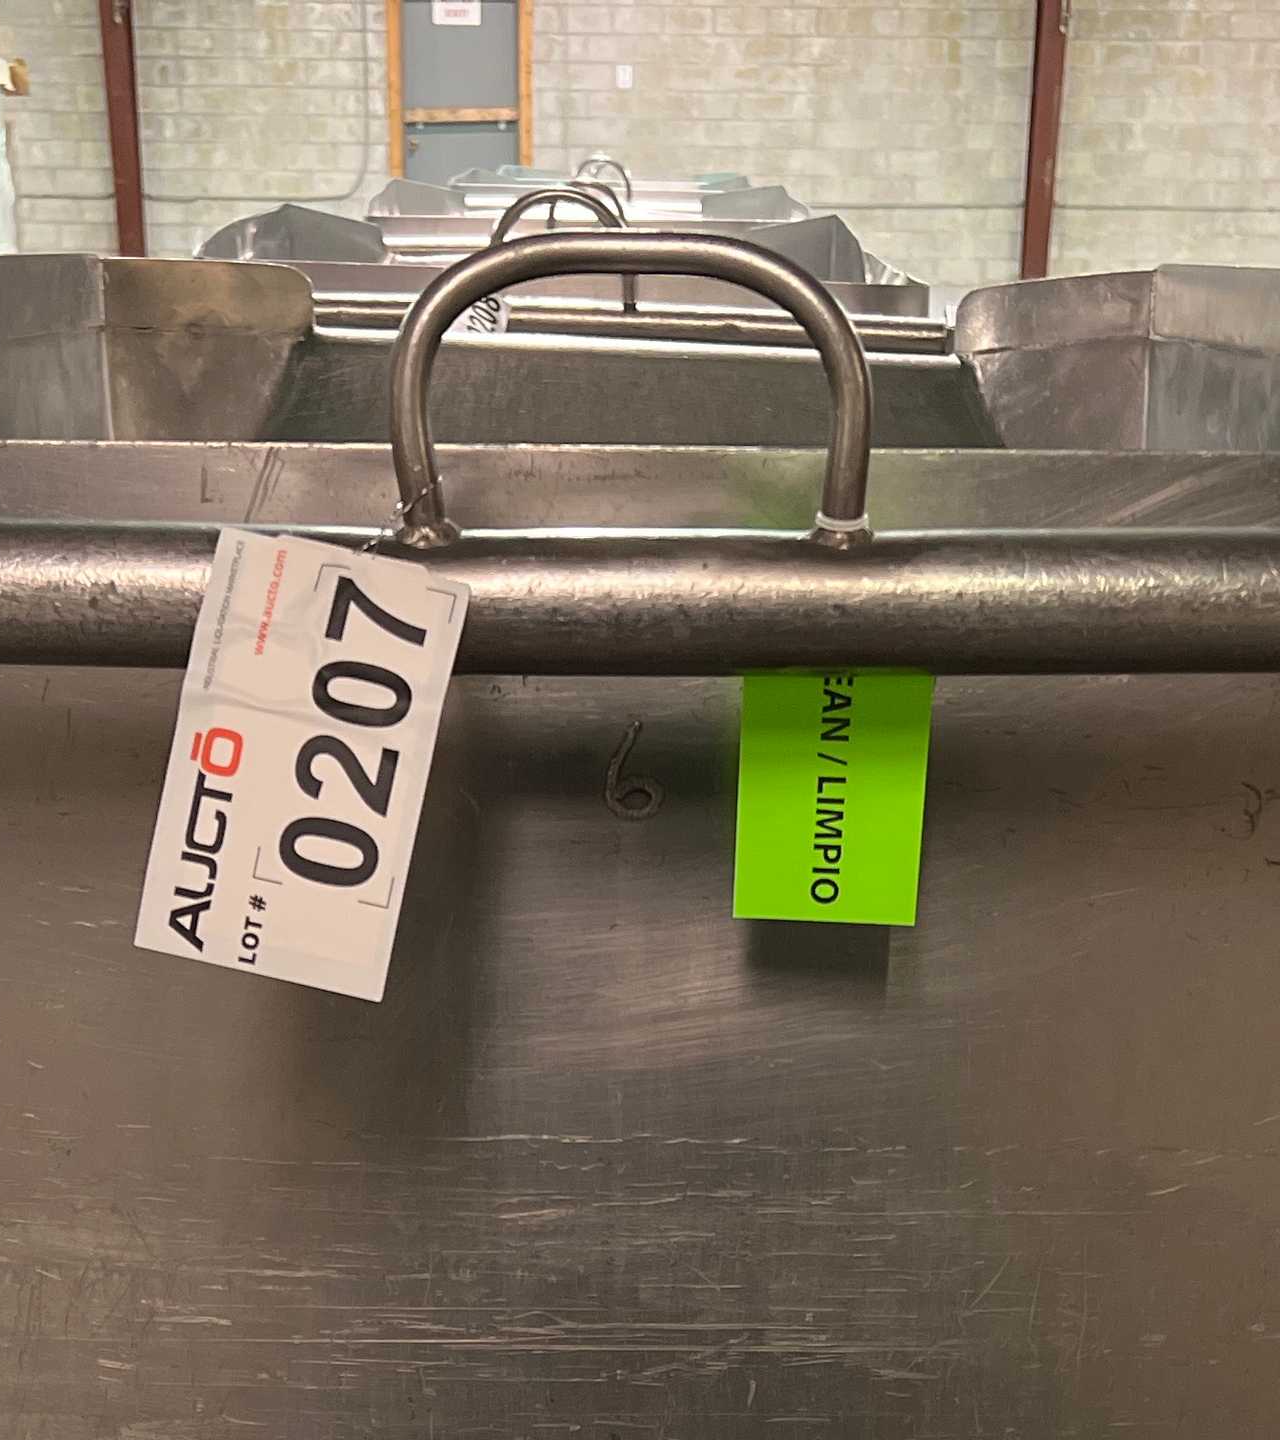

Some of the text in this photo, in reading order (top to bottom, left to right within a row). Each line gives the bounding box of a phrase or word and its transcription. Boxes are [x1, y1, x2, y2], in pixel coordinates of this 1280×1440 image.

[467, 296, 500, 333] 208
[254, 549, 287, 656] www.aucto.com
[279, 575, 427, 888] 0207
[817, 752, 848, 766] /
[810, 776, 847, 905] LIMPIO
[238, 894, 267, 965] LOT #
